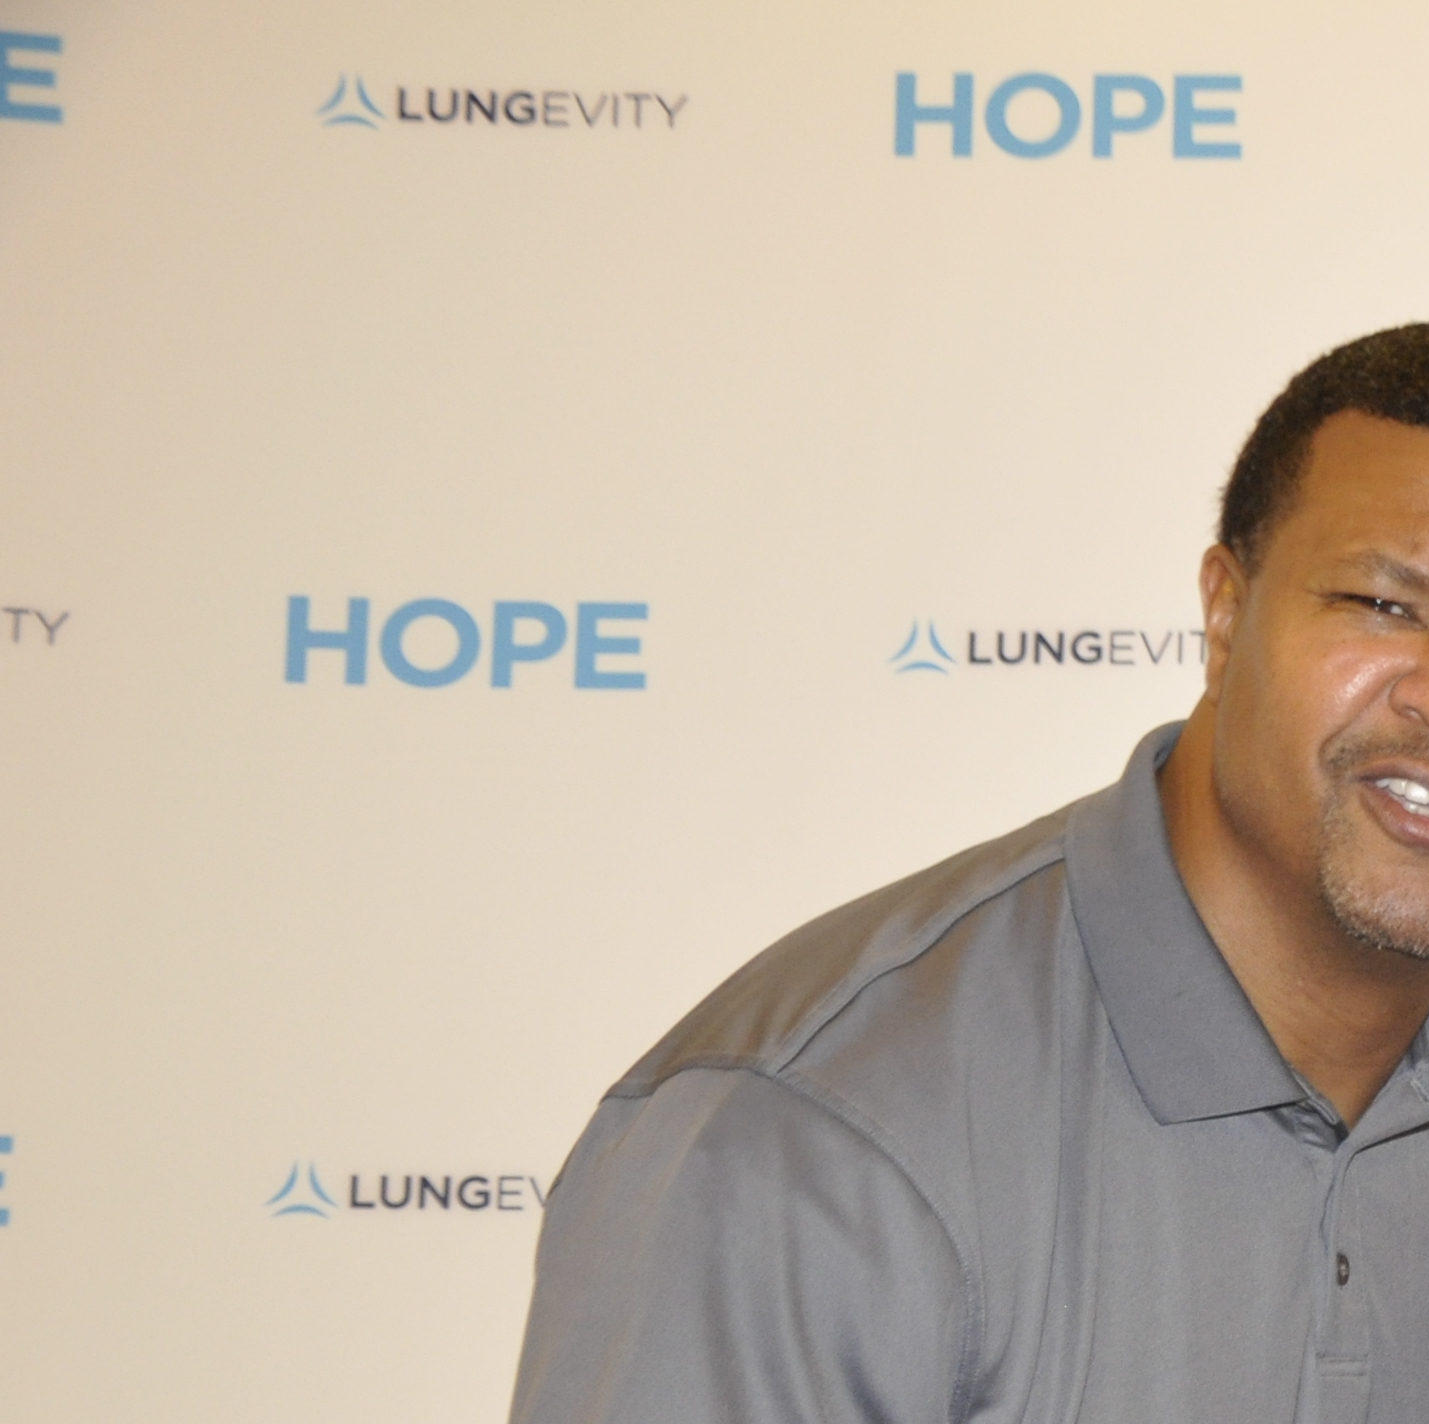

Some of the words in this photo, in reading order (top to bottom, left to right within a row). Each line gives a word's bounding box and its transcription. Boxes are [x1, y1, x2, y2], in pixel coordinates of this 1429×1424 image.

[395, 84, 687, 129] LUNGEVITY
[893, 70, 1244, 161] HOPE
[284, 594, 650, 692] HOPE
